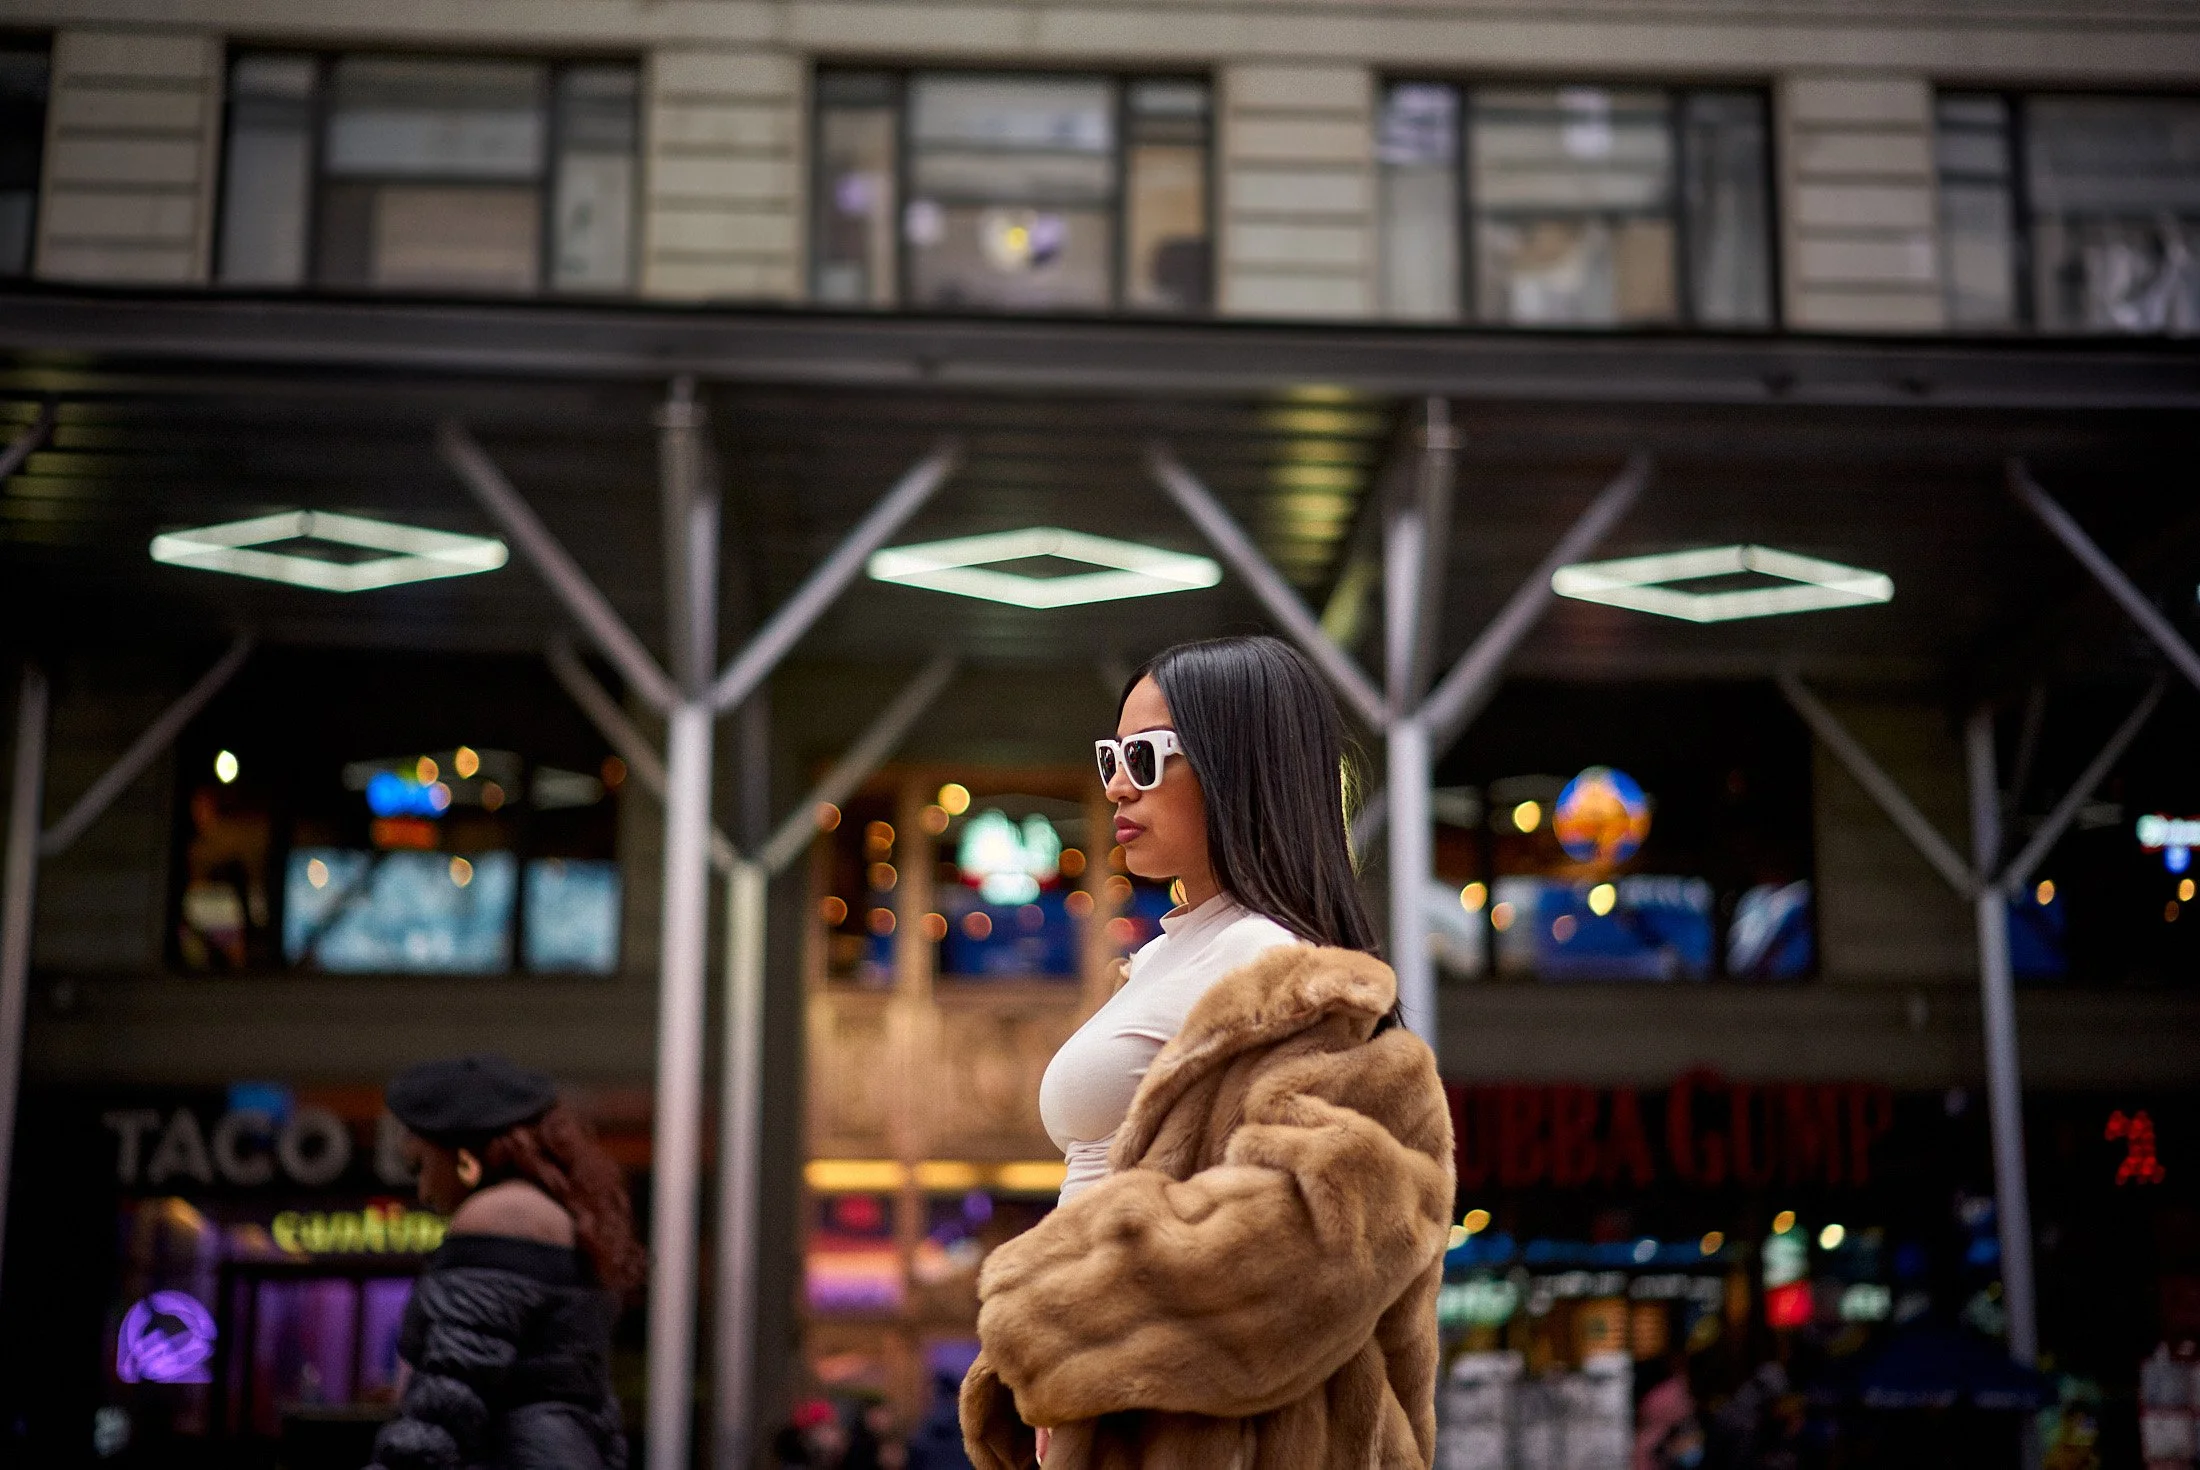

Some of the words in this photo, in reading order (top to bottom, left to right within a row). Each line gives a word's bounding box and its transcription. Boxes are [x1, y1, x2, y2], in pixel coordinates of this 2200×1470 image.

[101, 1104, 353, 1189] TACO
[1446, 1080, 1656, 1190] UBBA
[1667, 1068, 1896, 1190] GUMP
